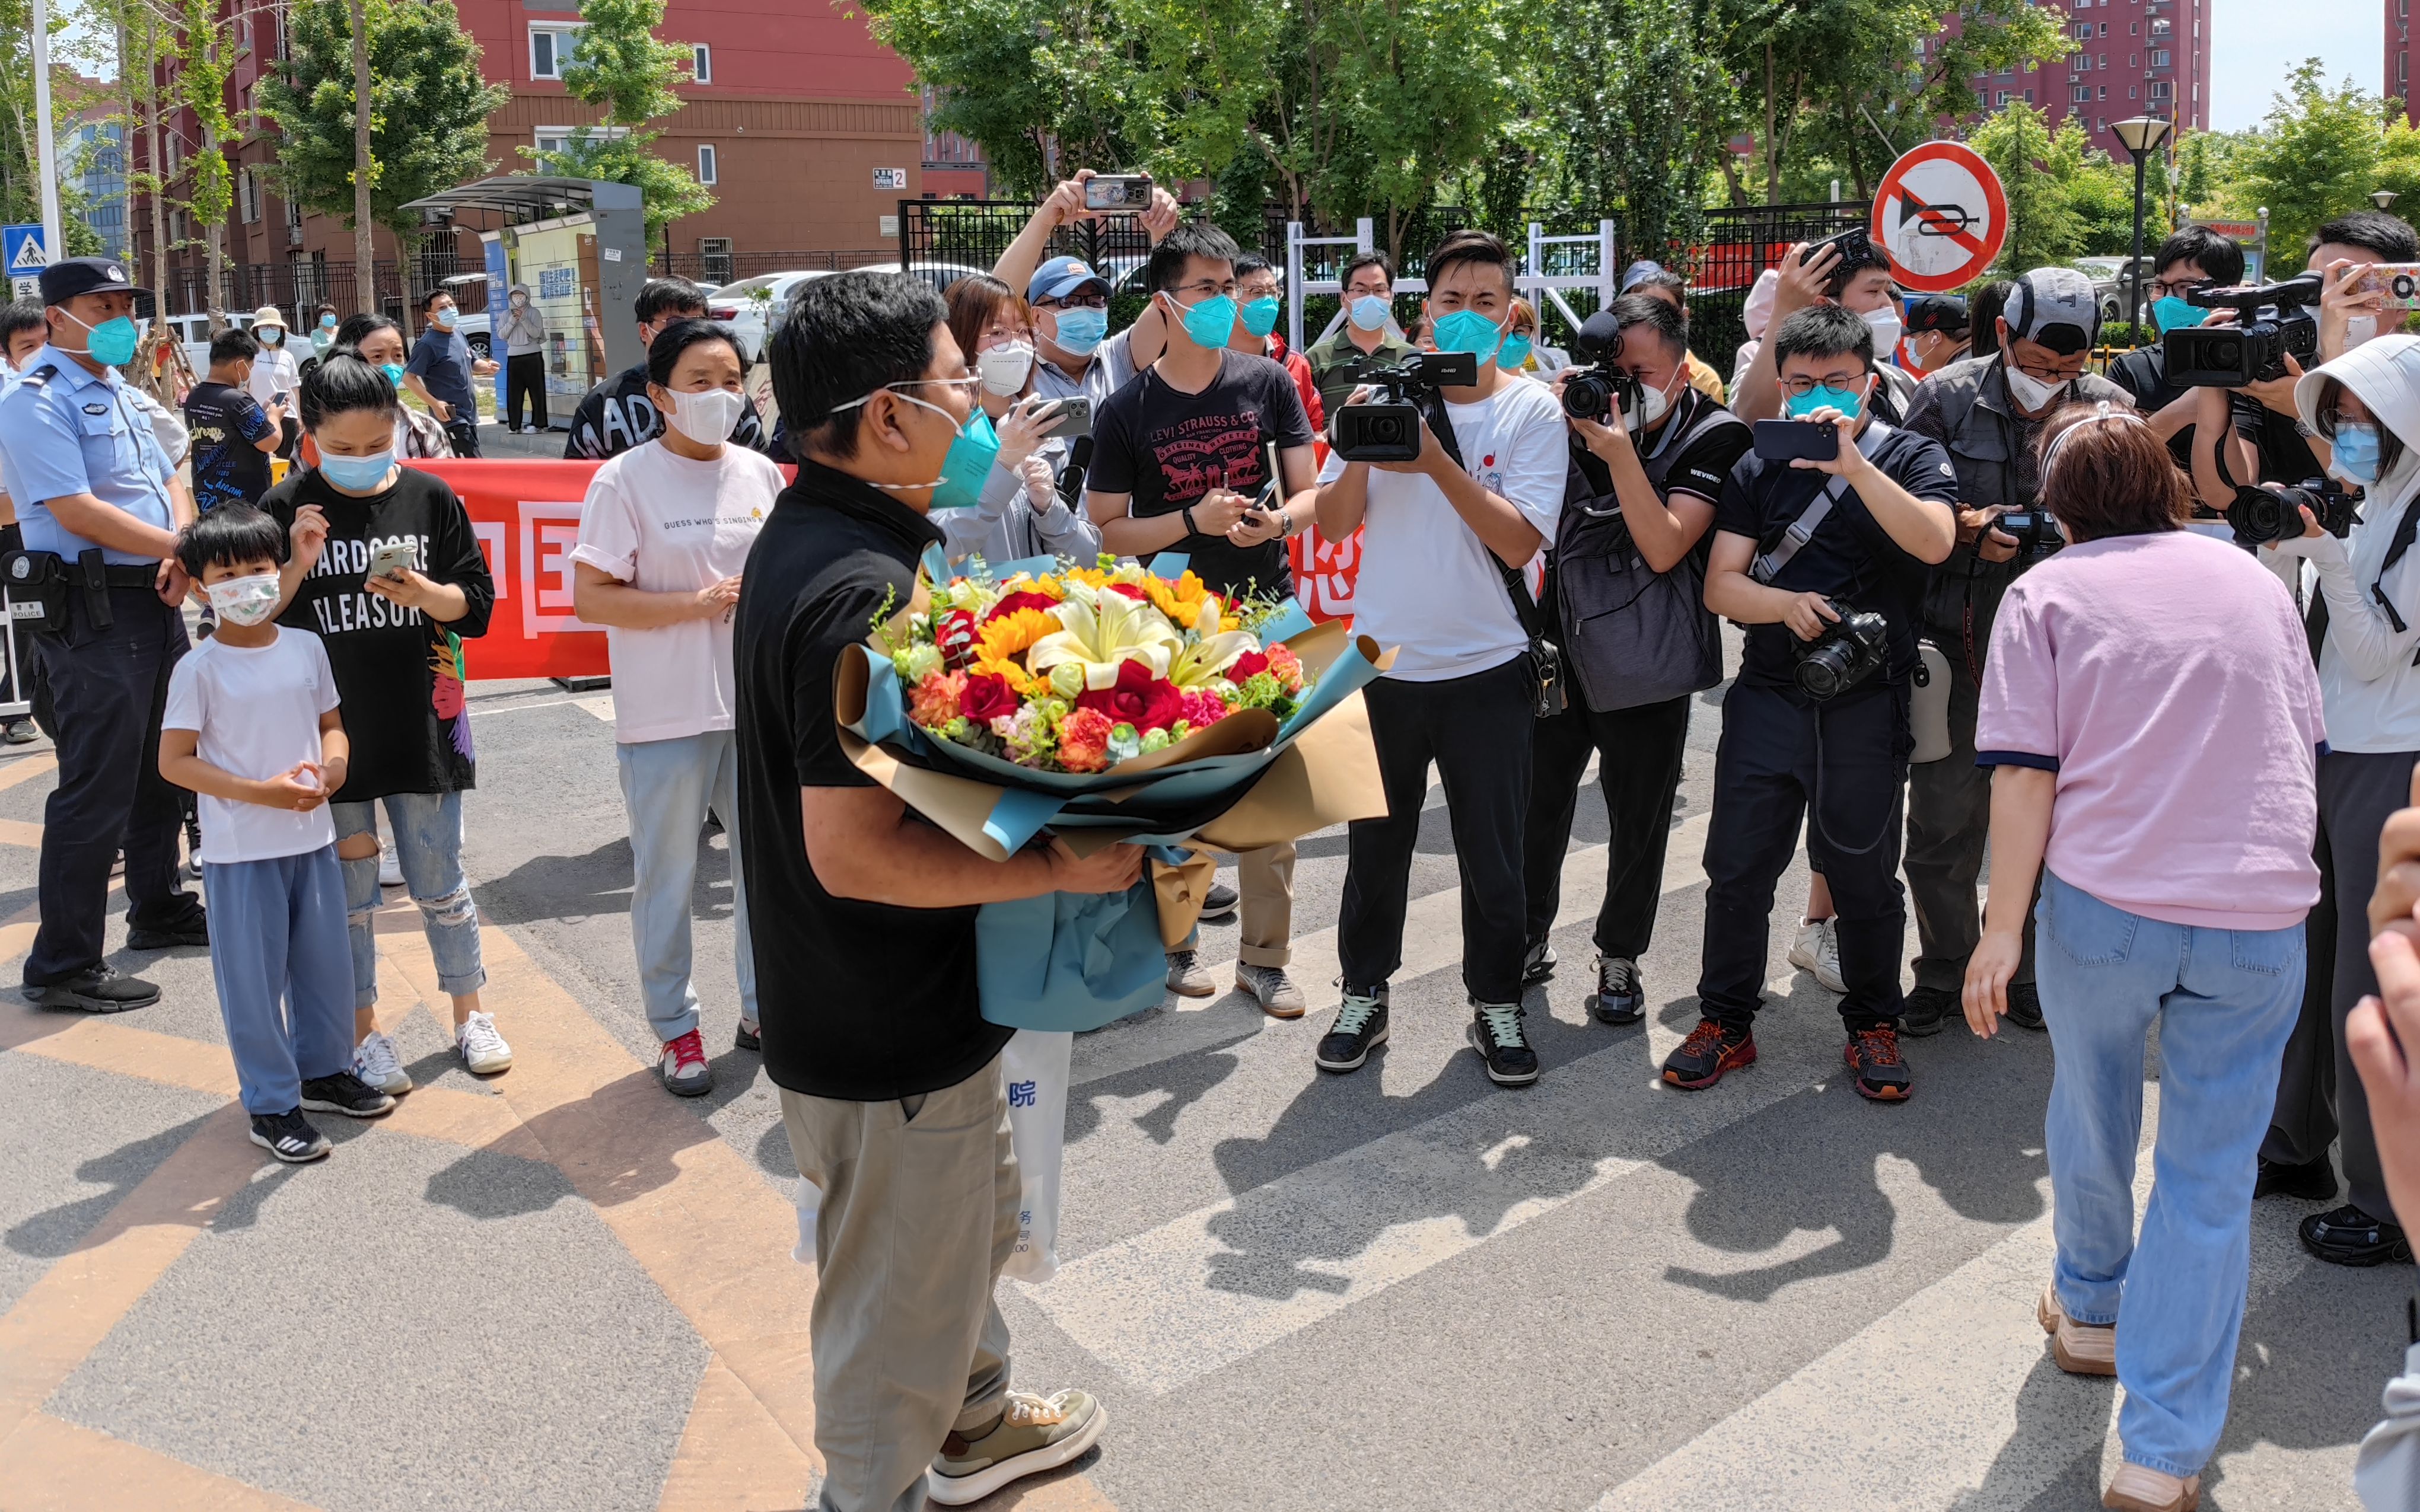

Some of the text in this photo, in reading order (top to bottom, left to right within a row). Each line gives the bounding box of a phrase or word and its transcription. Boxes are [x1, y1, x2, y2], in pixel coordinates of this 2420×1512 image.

[896, 173, 903, 185] 2
[18, 282, 42, 296] 学
[1150, 411, 1258, 442] LEVI STRAUSS & CO.
[1159, 432, 1256, 458] ORIGINAL RIVETED
[1173, 443, 1247, 464] QUALITY CLOTHING
[1690, 468, 1721, 484] WEVIDEO
[664, 521, 692, 529] GUESS
[1856, 631, 1869, 645] Canon
[1010, 1080, 1036, 1108] 院
[1020, 1211, 1032, 1225] 务
